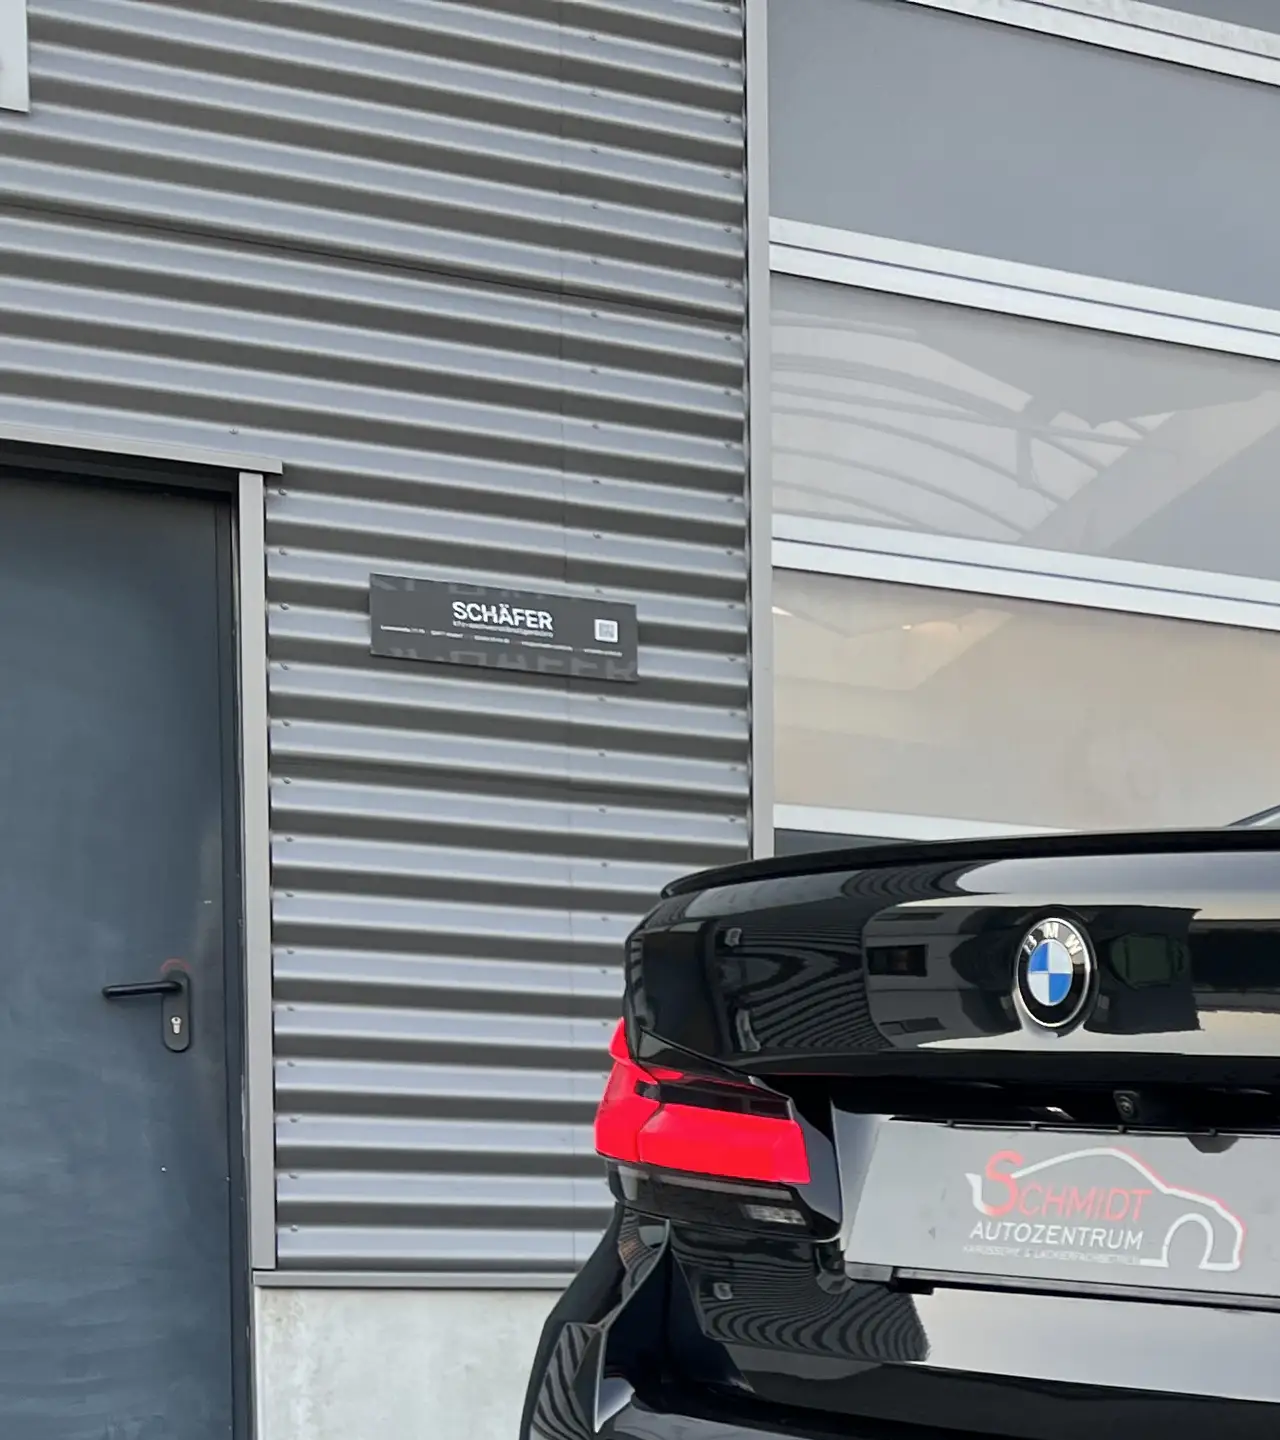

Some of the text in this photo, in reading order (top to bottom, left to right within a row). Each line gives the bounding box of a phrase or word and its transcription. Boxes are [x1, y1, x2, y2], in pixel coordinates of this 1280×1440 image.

[452, 601, 553, 631] SCHÄFER
[1023, 921, 1083, 955] BMW
[985, 1149, 1152, 1222] SCHMIDT
[969, 1221, 1144, 1250] AUTOZENTRUM
